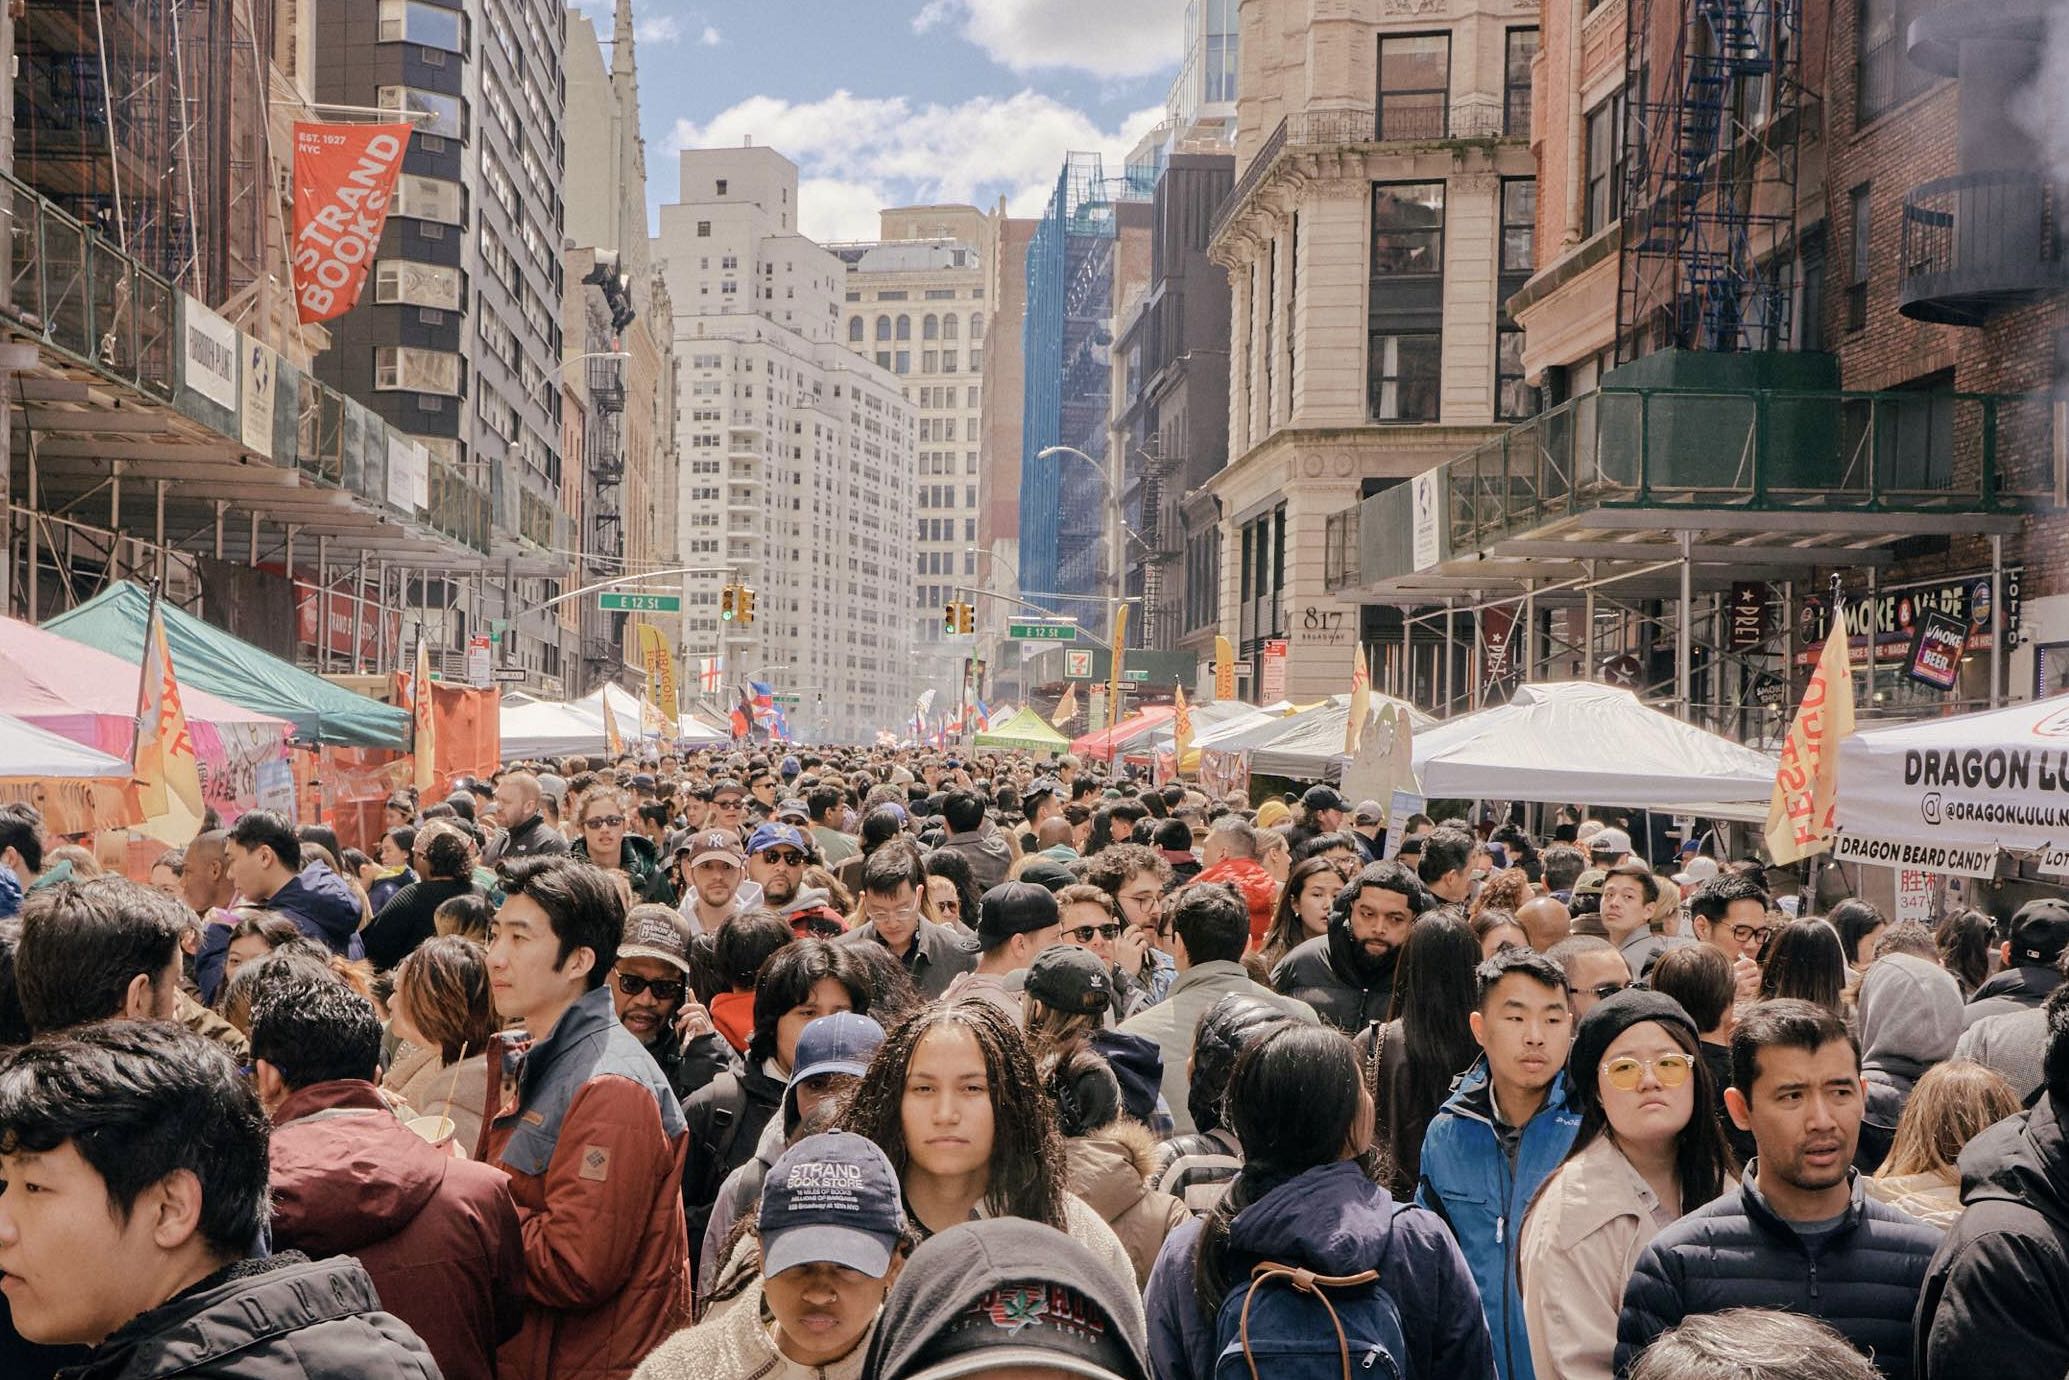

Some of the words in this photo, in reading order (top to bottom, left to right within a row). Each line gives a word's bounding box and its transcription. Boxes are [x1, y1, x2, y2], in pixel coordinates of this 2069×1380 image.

[298, 132, 321, 143] EST.
[323, 135, 346, 145] 1927
[298, 143, 320, 155] NYC
[295, 134, 400, 272] STRAND
[621, 596, 628, 608] E
[632, 597, 643, 608] 12
[647, 598, 659, 609] St
[2008, 571, 2019, 644] LOTTO
[1026, 627, 1033, 637] E
[1036, 628, 1046, 637] 12
[1049, 628, 1059, 638] St
[1303, 606, 1343, 646] 817
[1925, 624, 1964, 649] SMOKE
[1922, 649, 1949, 672] BEER
[659, 648, 673, 703] DRAGON
[1904, 748, 2033, 789] DRAGON
[1841, 837, 1901, 862] DRAGON
[1902, 845, 1946, 868] BEARD
[1948, 850, 1992, 872] CANDY
[790, 1163, 861, 1180] STRAND
[787, 1178, 820, 1189] BOOK
[822, 1178, 865, 1190] STORE
